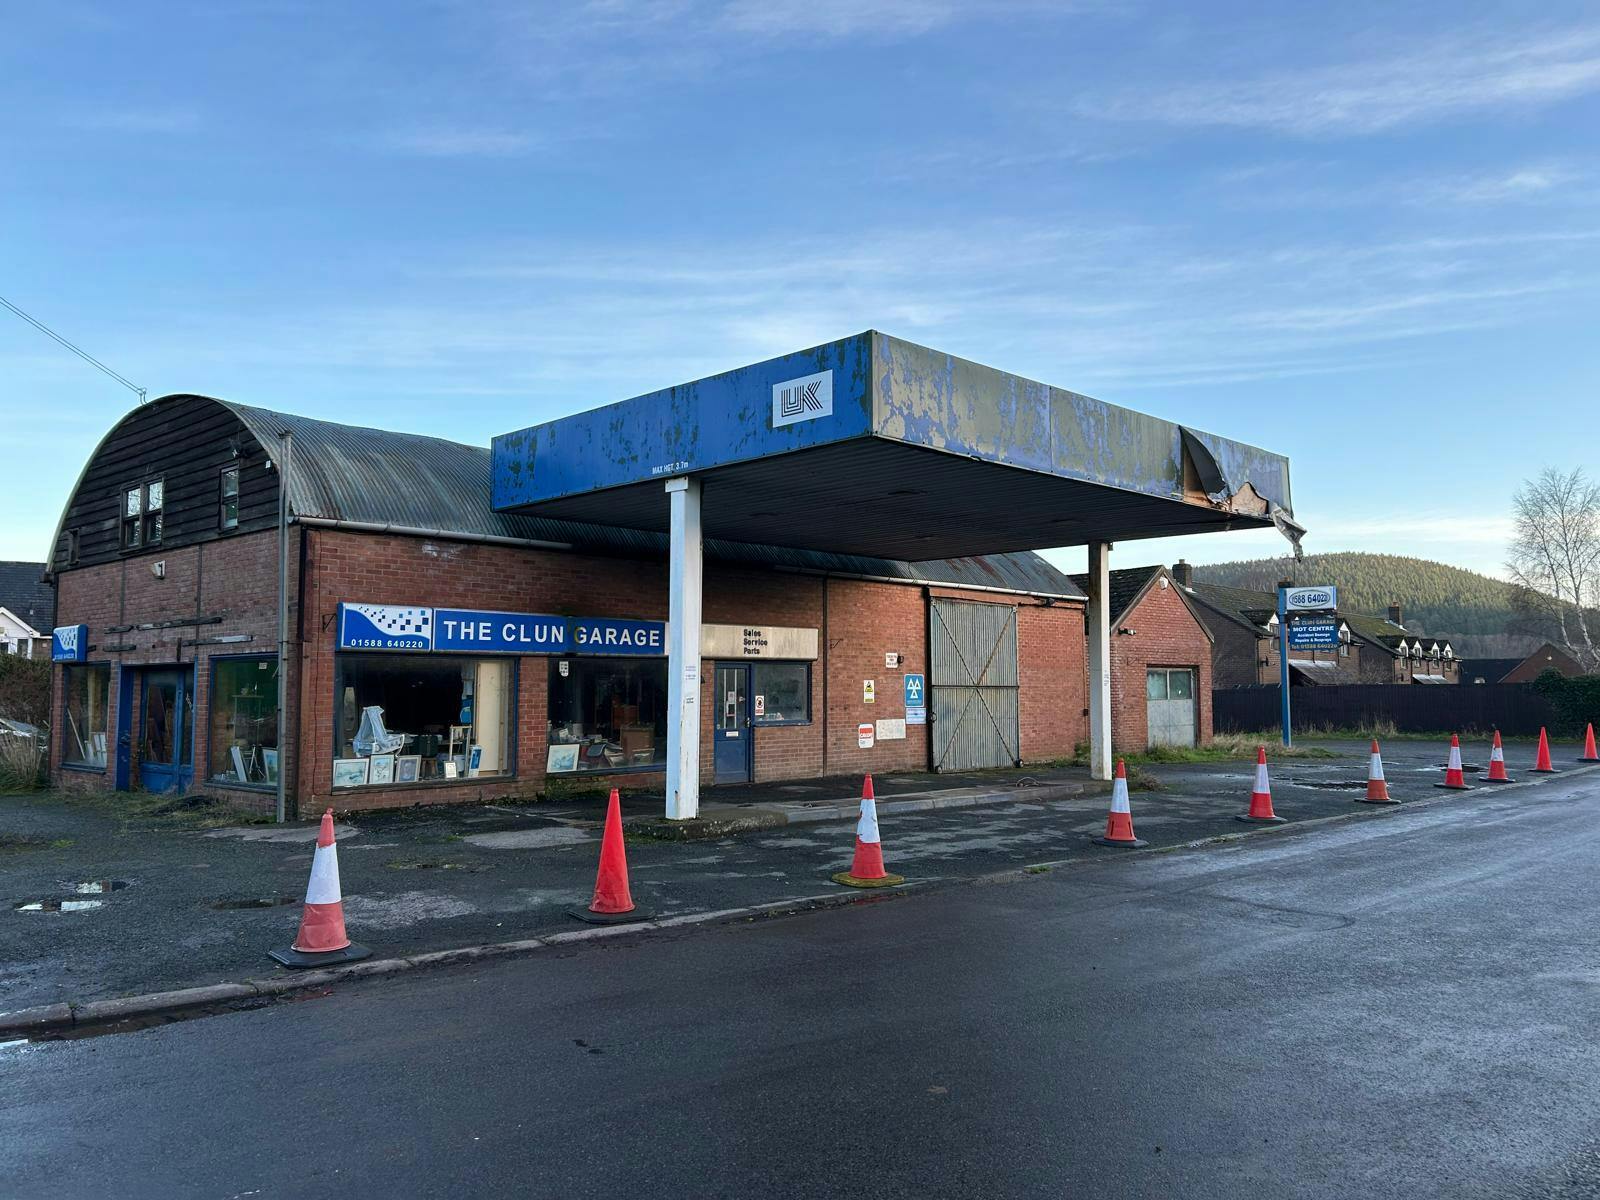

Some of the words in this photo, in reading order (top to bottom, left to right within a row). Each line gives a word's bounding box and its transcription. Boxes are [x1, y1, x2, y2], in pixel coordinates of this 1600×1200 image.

[781, 380, 823, 418] UK
[652, 465, 663, 475] MAX
[444, 620, 492, 641] THE
[502, 623, 564, 644] CLUN
[574, 626, 661, 648] GARAGE
[744, 628, 761, 637] Sales
[351, 638, 383, 648] 01588
[387, 639, 424, 649] 640220
[744, 638, 768, 646] Service
